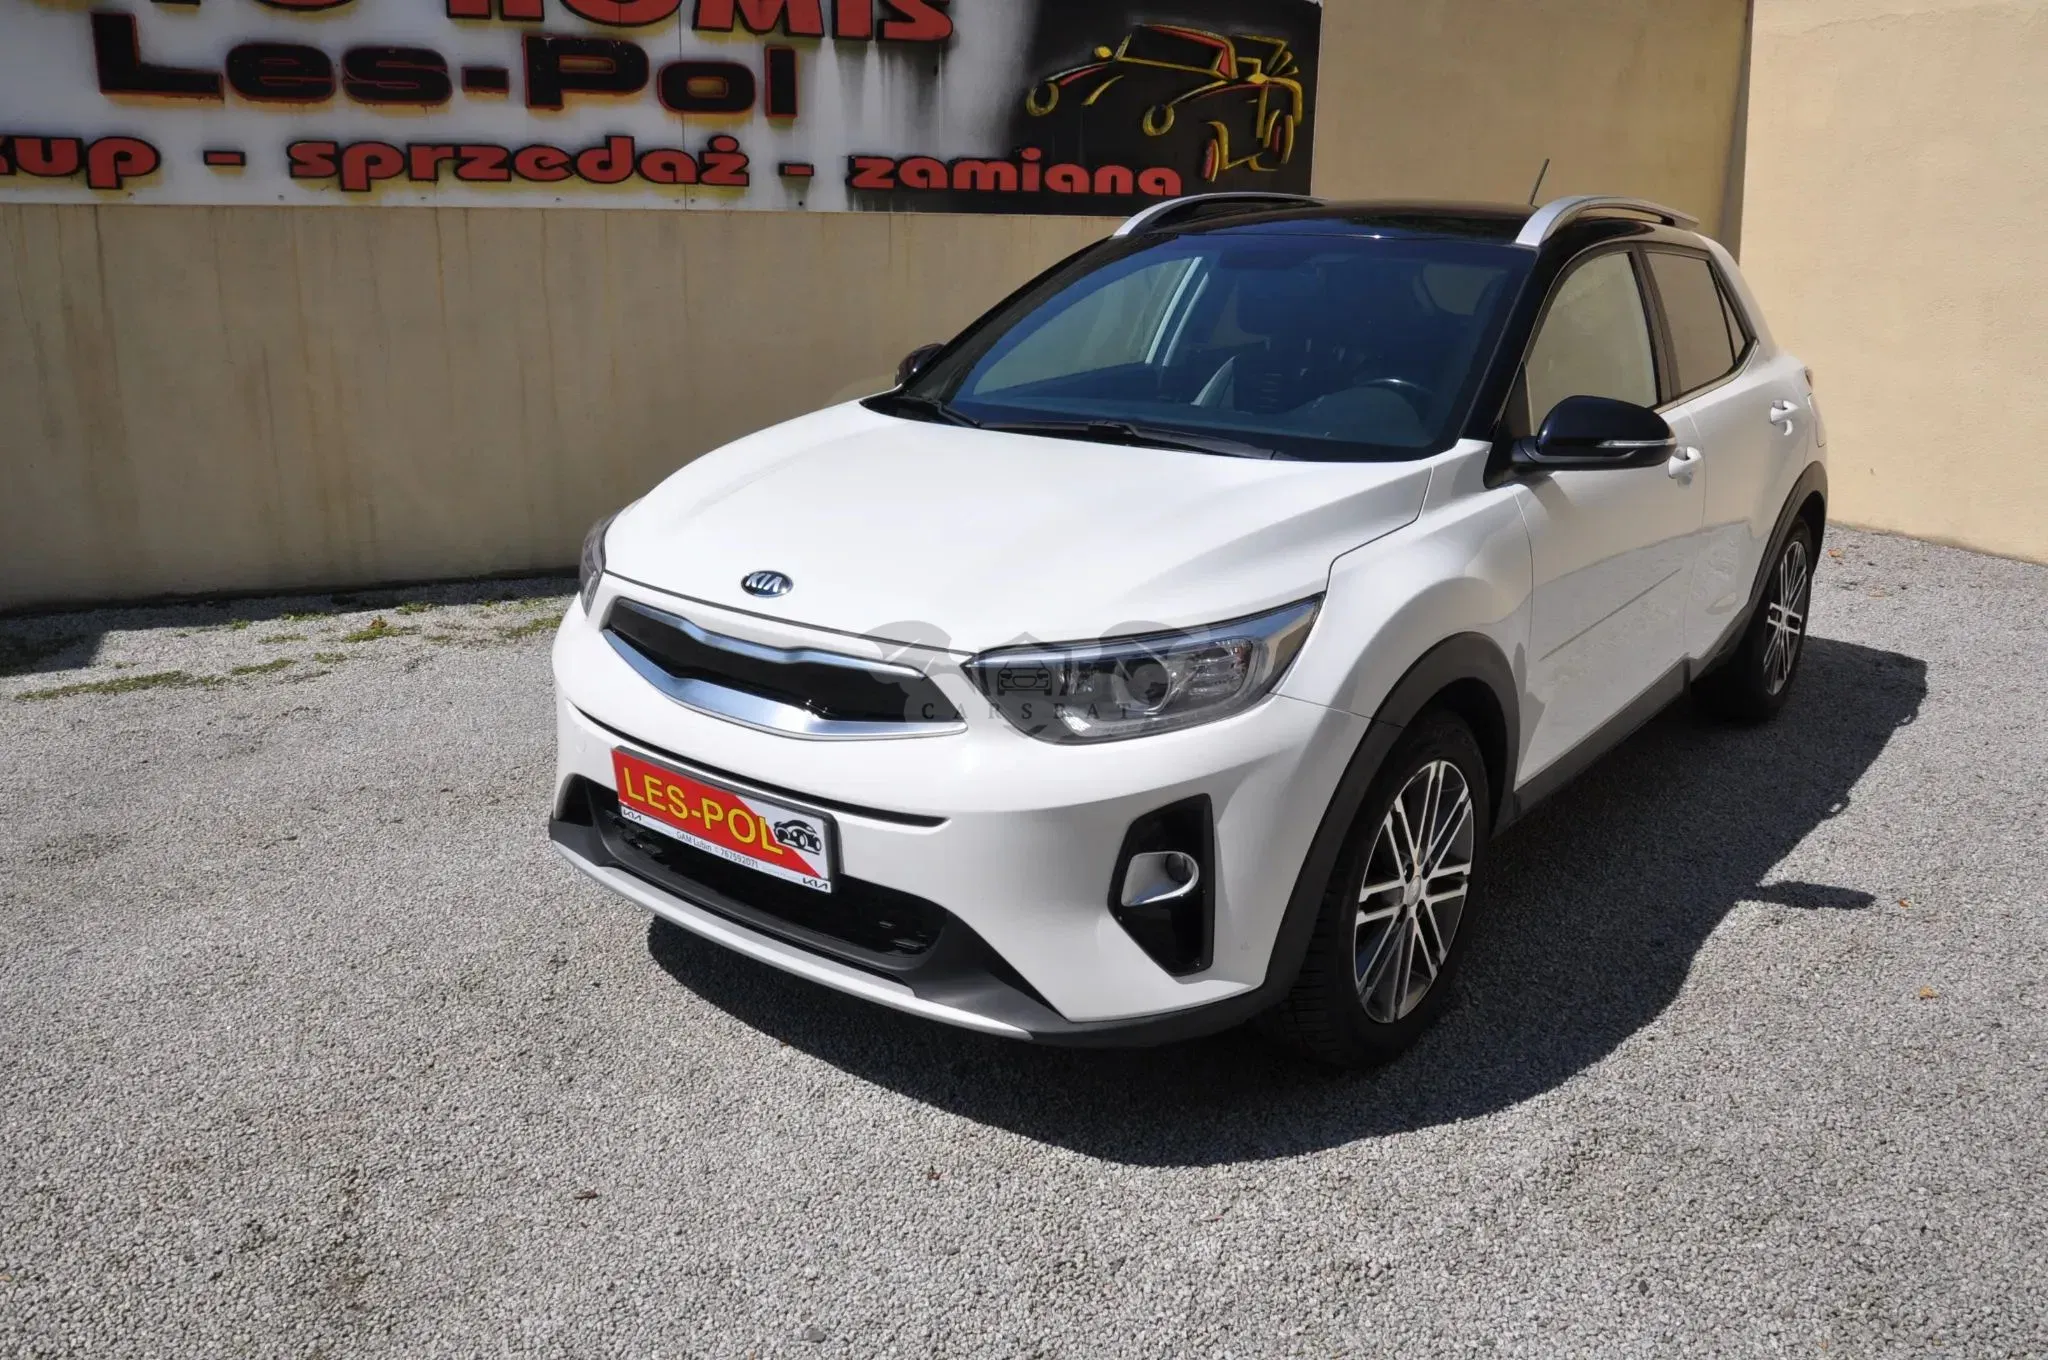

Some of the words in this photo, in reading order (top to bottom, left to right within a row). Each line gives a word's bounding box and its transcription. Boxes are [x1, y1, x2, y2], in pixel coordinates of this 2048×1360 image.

[0, 135, 161, 189] up
[286, 136, 750, 192] sprzedaż
[849, 147, 1183, 197] zamiana
[744, 572, 784, 593] KIA
[623, 766, 783, 855] LES-POL
[802, 877, 829, 890] KIA
